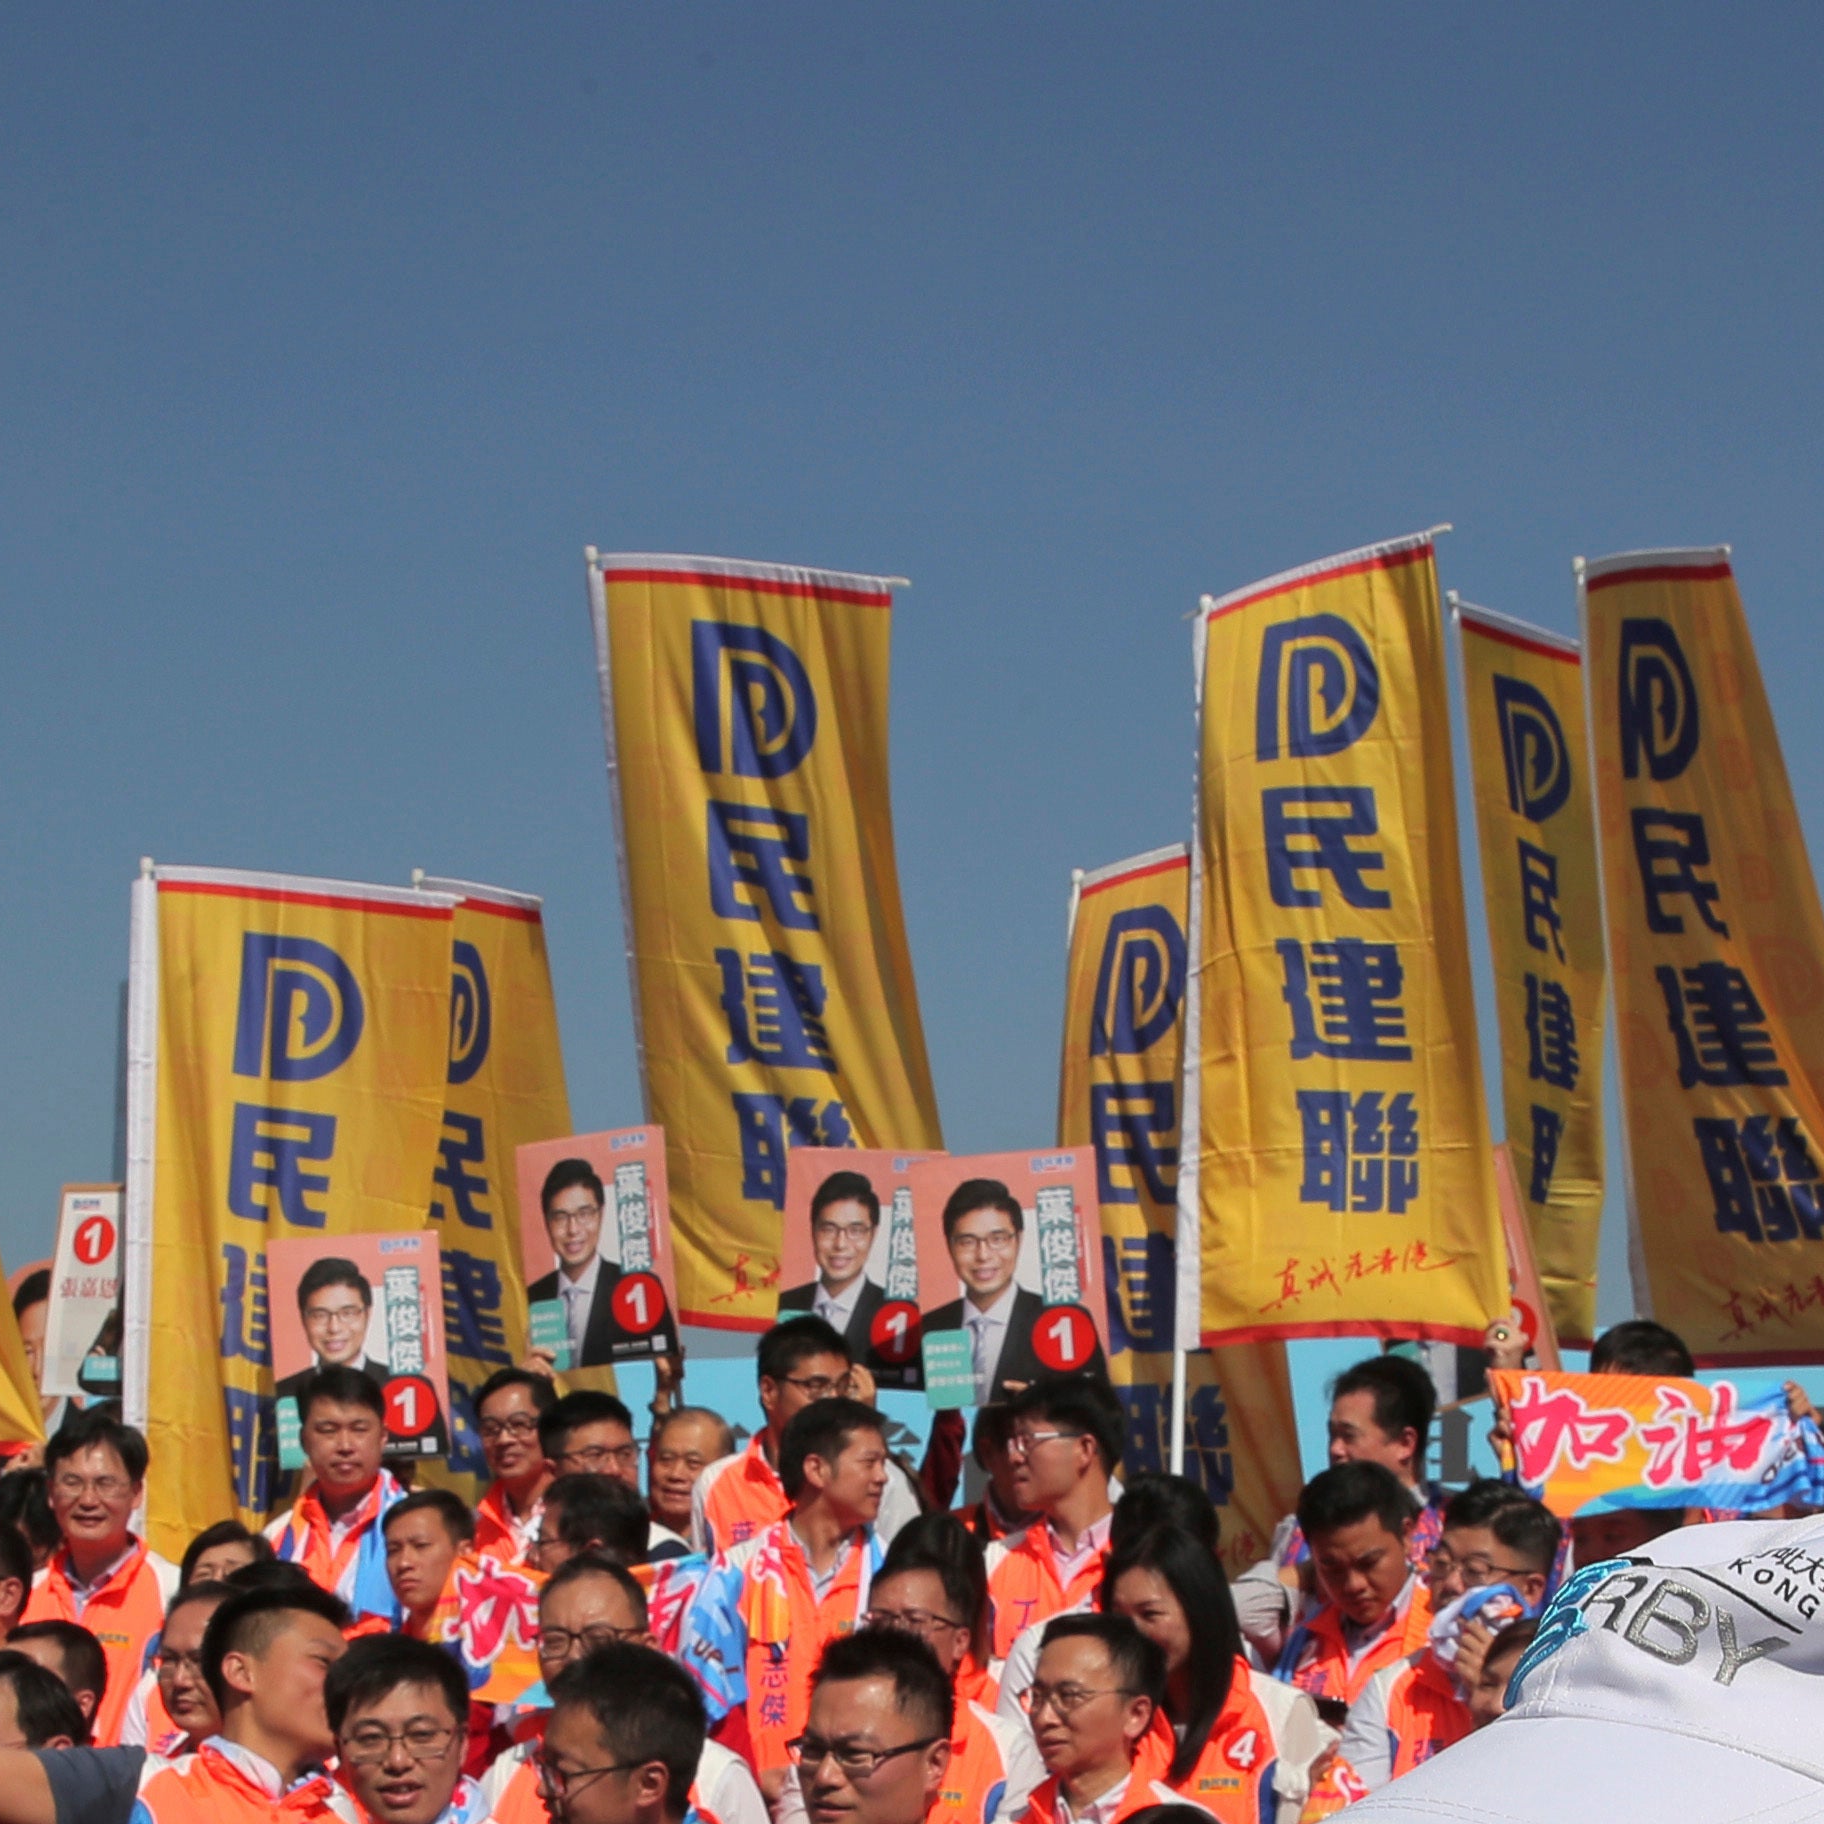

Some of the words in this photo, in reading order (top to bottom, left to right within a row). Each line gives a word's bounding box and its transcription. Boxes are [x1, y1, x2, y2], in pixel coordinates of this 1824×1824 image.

[1260, 785, 1419, 1216] 民建聯
[84, 1222, 103, 1259] 1
[625, 1282, 648, 1324] 1
[886, 1311, 908, 1354] 1
[1048, 1316, 1075, 1362] 1
[393, 1386, 417, 1428] 1
[1728, 1557, 1821, 1621] KONG
[1227, 1729, 1256, 1768] 4
